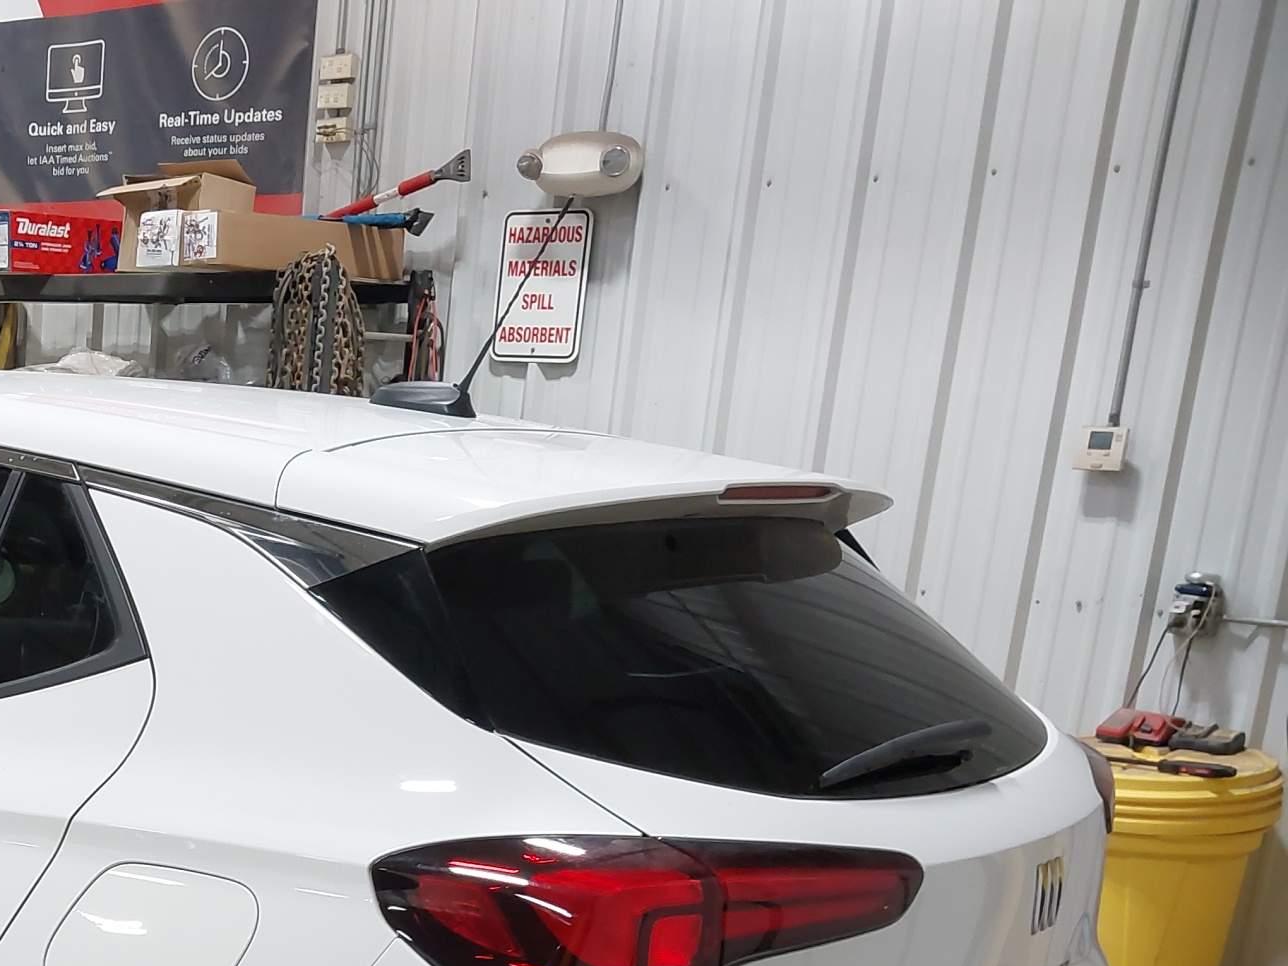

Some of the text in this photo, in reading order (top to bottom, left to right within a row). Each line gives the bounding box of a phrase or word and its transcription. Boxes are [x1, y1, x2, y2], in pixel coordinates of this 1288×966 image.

[159, 107, 283, 128] Real-Time Updates
[28, 118, 116, 137] Quick and Easy
[45, 139, 98, 153] Insert max bid,
[171, 131, 265, 146] Receive status updates
[183, 143, 249, 157] about your bids
[27, 155, 38, 166] let
[39, 155, 55, 165] IAA
[56, 153, 78, 165] Timed
[52, 166, 90, 176] bid for you
[16, 217, 71, 238] Duralast
[508, 225, 583, 244] HAZARDOUS
[507, 260, 577, 277] MATERIALS
[521, 294, 554, 310] SPILL
[498, 326, 571, 344] ABSORBENT
